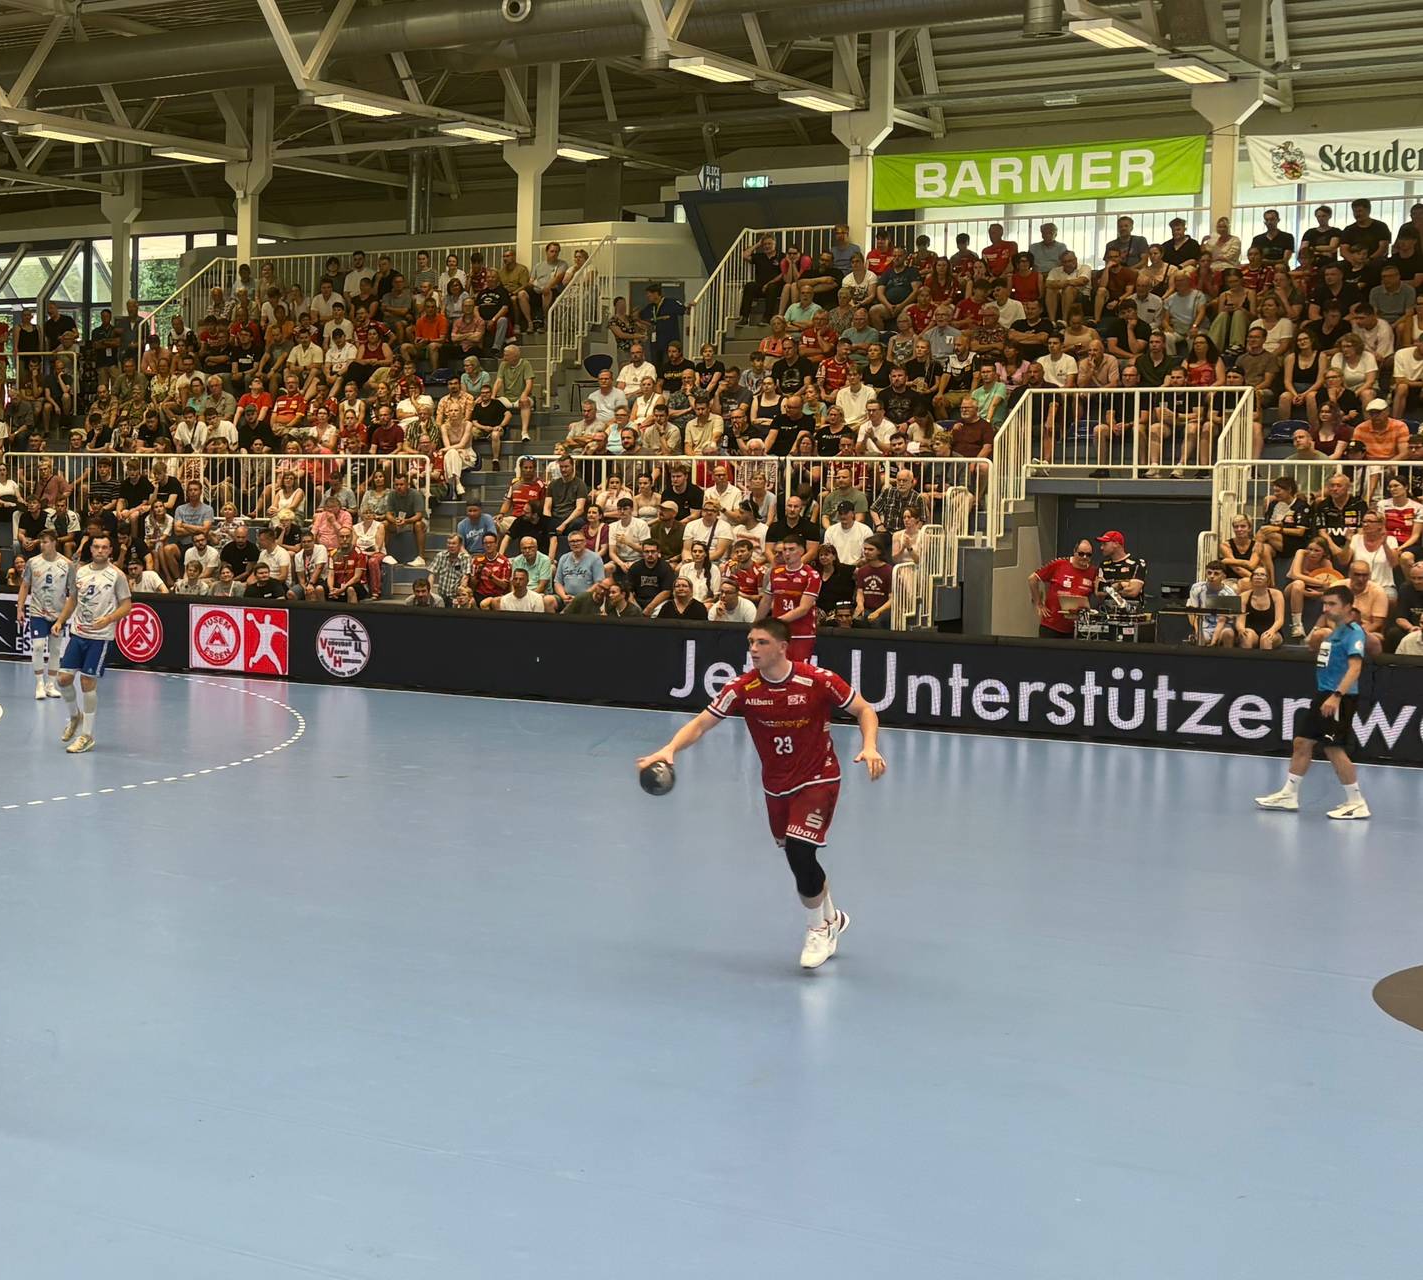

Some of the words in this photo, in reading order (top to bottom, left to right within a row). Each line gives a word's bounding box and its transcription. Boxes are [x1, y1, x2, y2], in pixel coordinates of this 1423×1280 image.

[914, 149, 1156, 199] BARMER
[203, 616, 232, 631] TUSEM
[203, 646, 232, 661] ESSEN
[851, 648, 1312, 741] Unterstützer
[1351, 700, 1423, 751] w
[773, 735, 794, 755] 23
